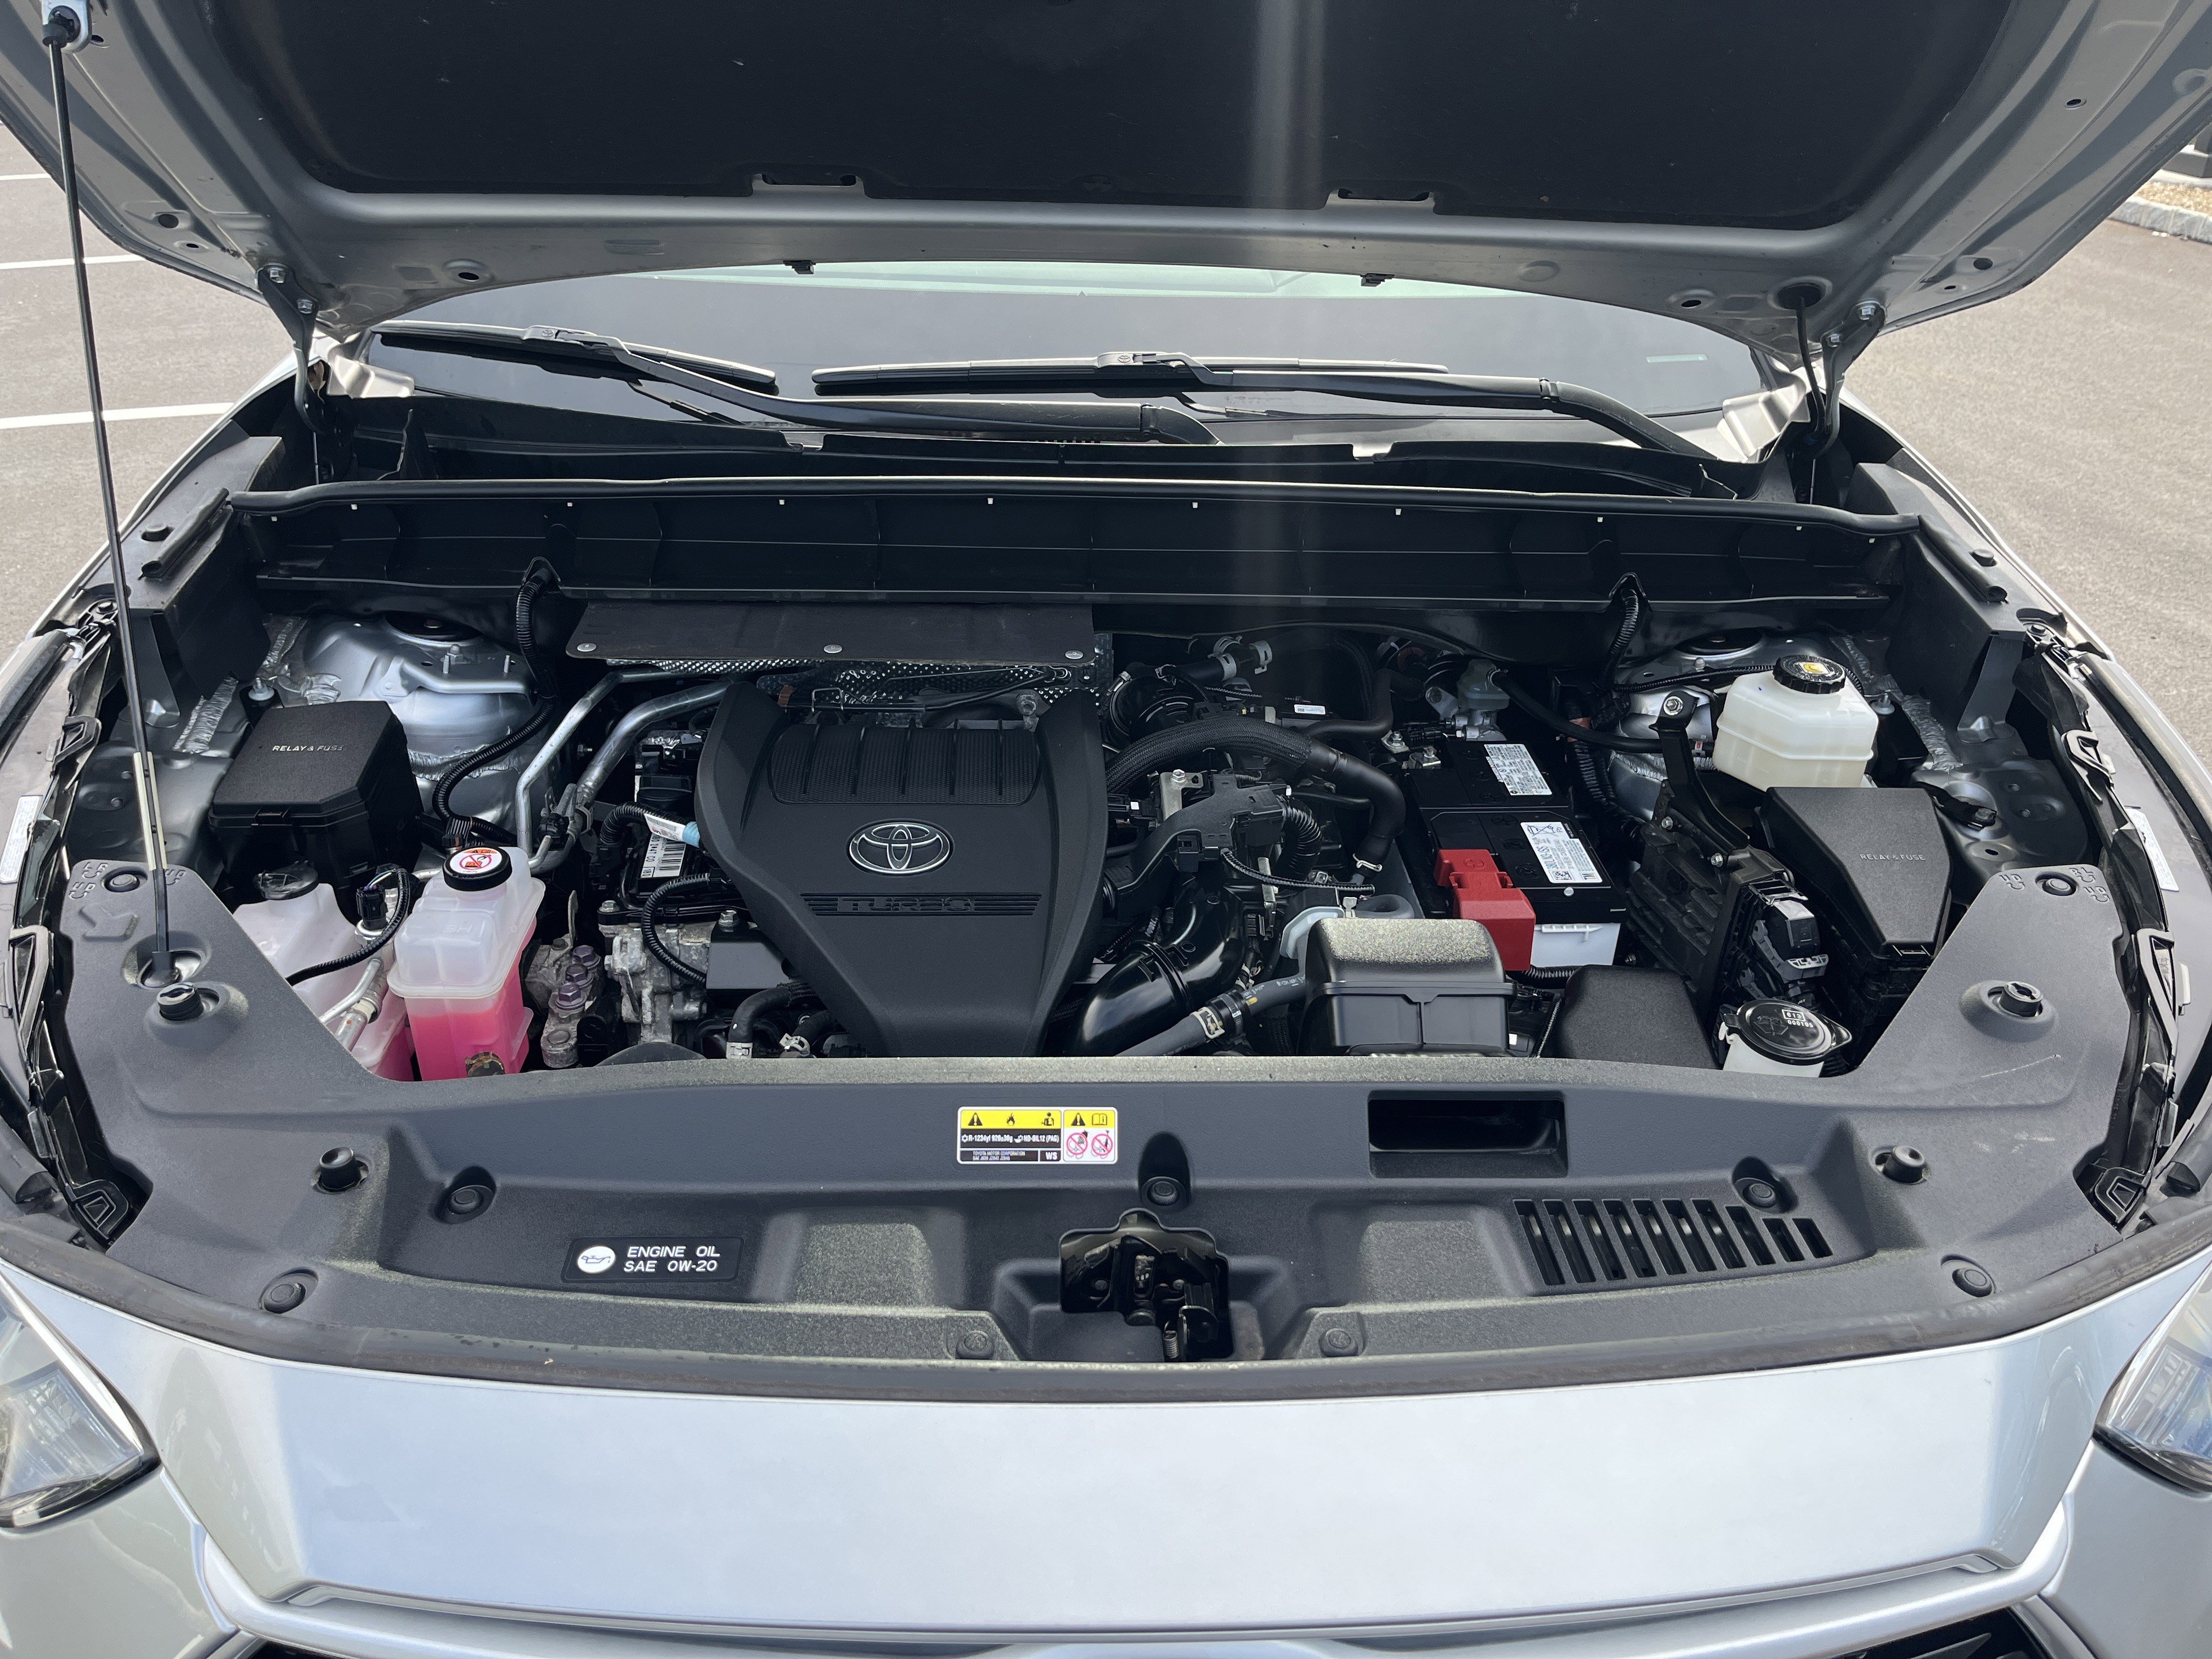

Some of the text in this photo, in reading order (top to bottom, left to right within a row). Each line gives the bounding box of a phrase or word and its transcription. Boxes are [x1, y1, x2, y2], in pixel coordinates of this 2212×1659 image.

[841, 896, 973, 912] TURBO
[1787, 1019, 1814, 1028] 000105
[1045, 1152, 1058, 1160] WS
[627, 1245, 720, 1257] ENGINE OIL
[623, 1260, 718, 1272] SAE 0W-20
